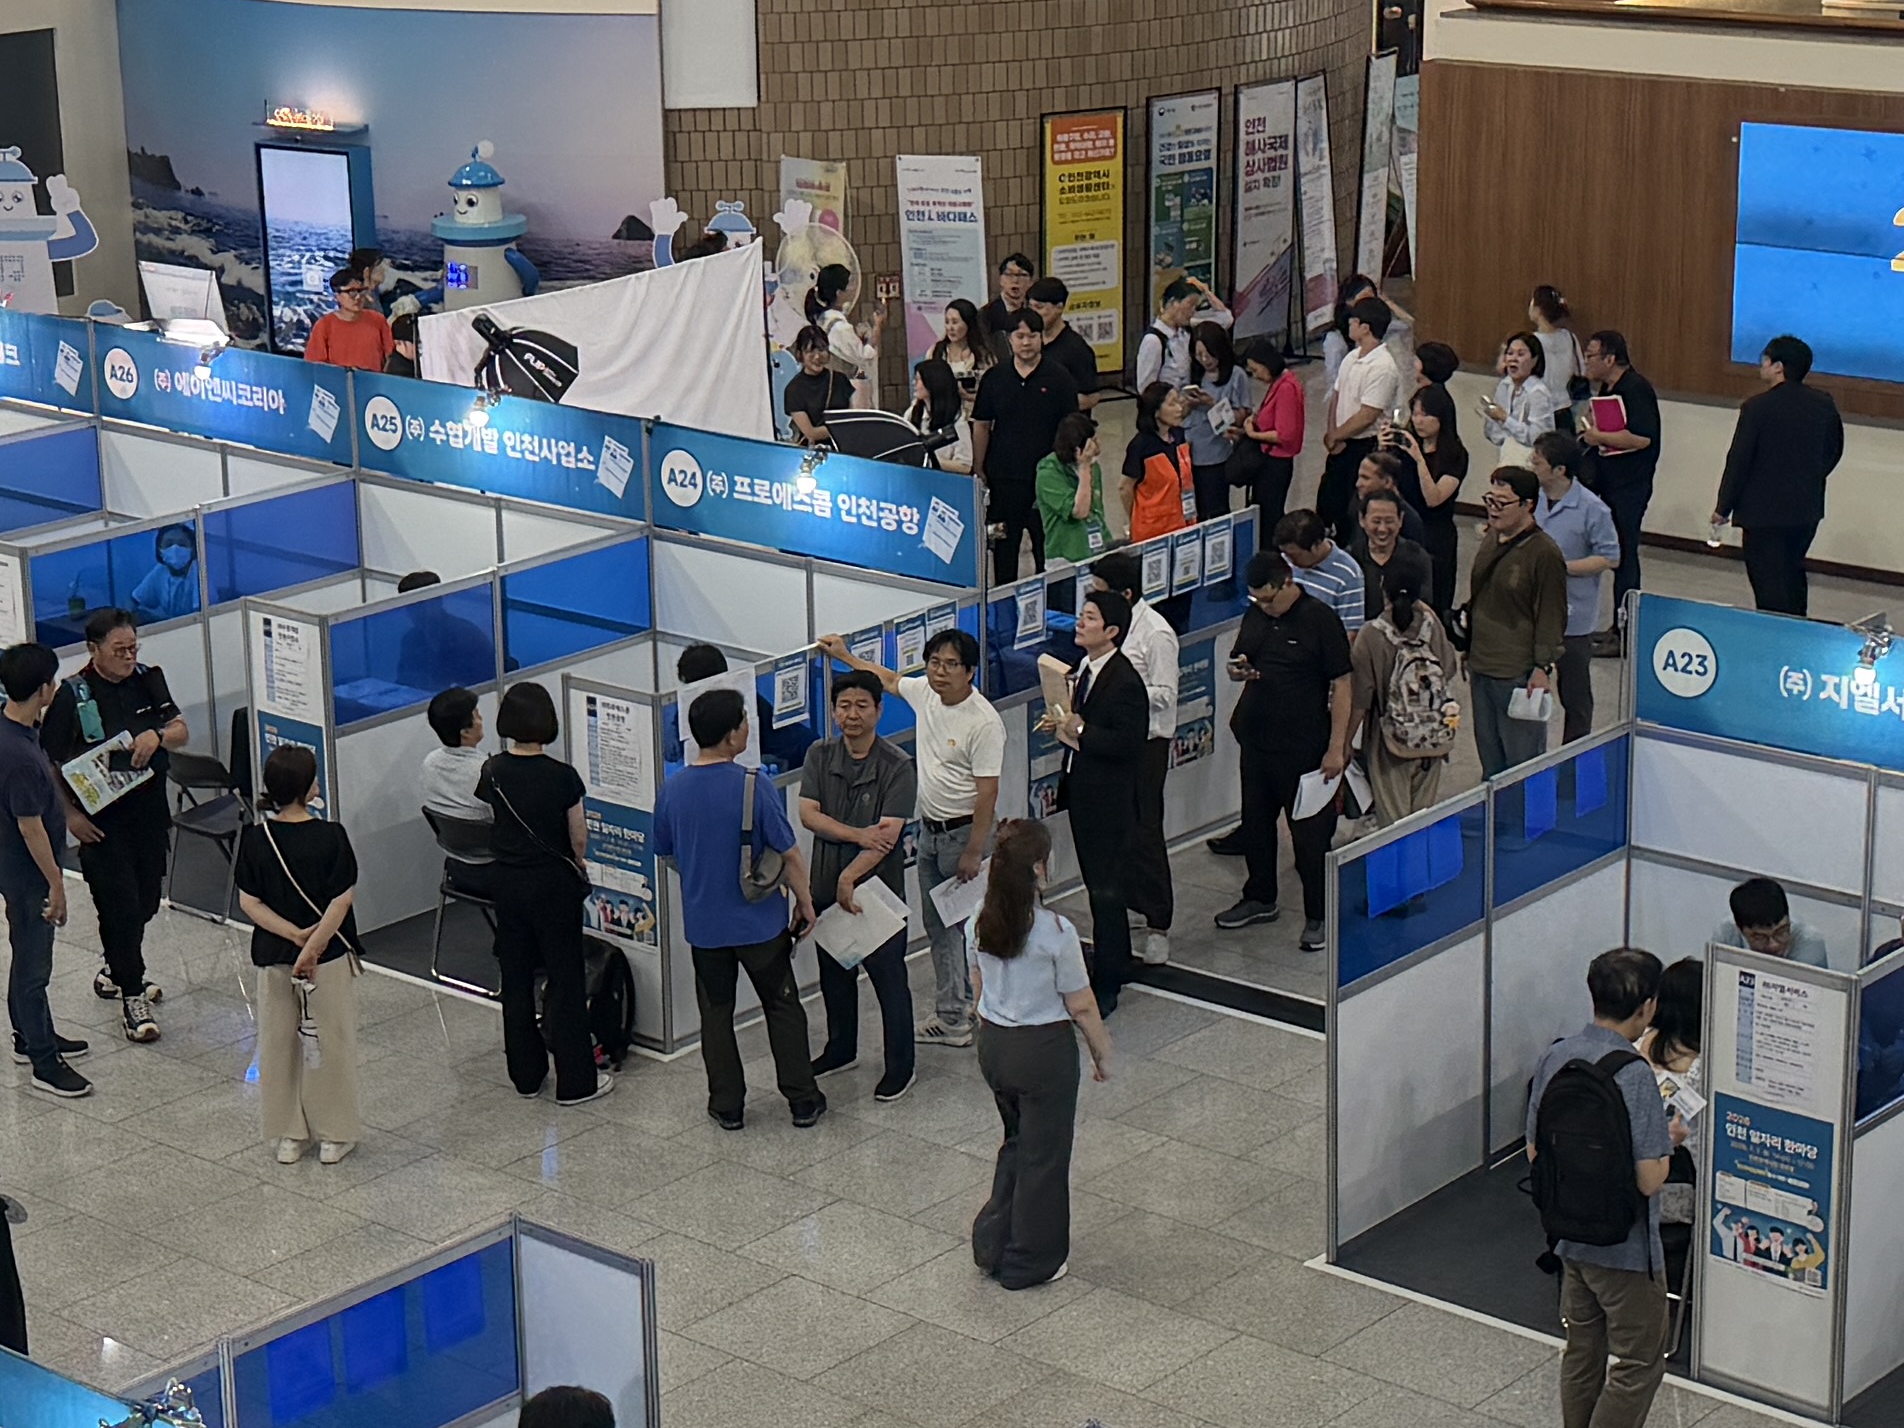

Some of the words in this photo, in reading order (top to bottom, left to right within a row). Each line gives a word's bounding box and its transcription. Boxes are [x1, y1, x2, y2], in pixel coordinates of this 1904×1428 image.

[109, 364, 134, 384] A26
[154, 367, 172, 396] (주)
[174, 373, 286, 416] 에이엔씨코리아
[370, 413, 399, 434] A25
[405, 414, 426, 442] (주)
[428, 420, 499, 457] 수협개발
[502, 430, 595, 472] 인천사업소
[666, 468, 699, 490] A24
[706, 470, 729, 500] (주)
[732, 474, 834, 519] 프로에스콤
[836, 492, 921, 536] 인천공항
[1661, 649, 1710, 679] A23
[1778, 664, 1812, 702] (주)
